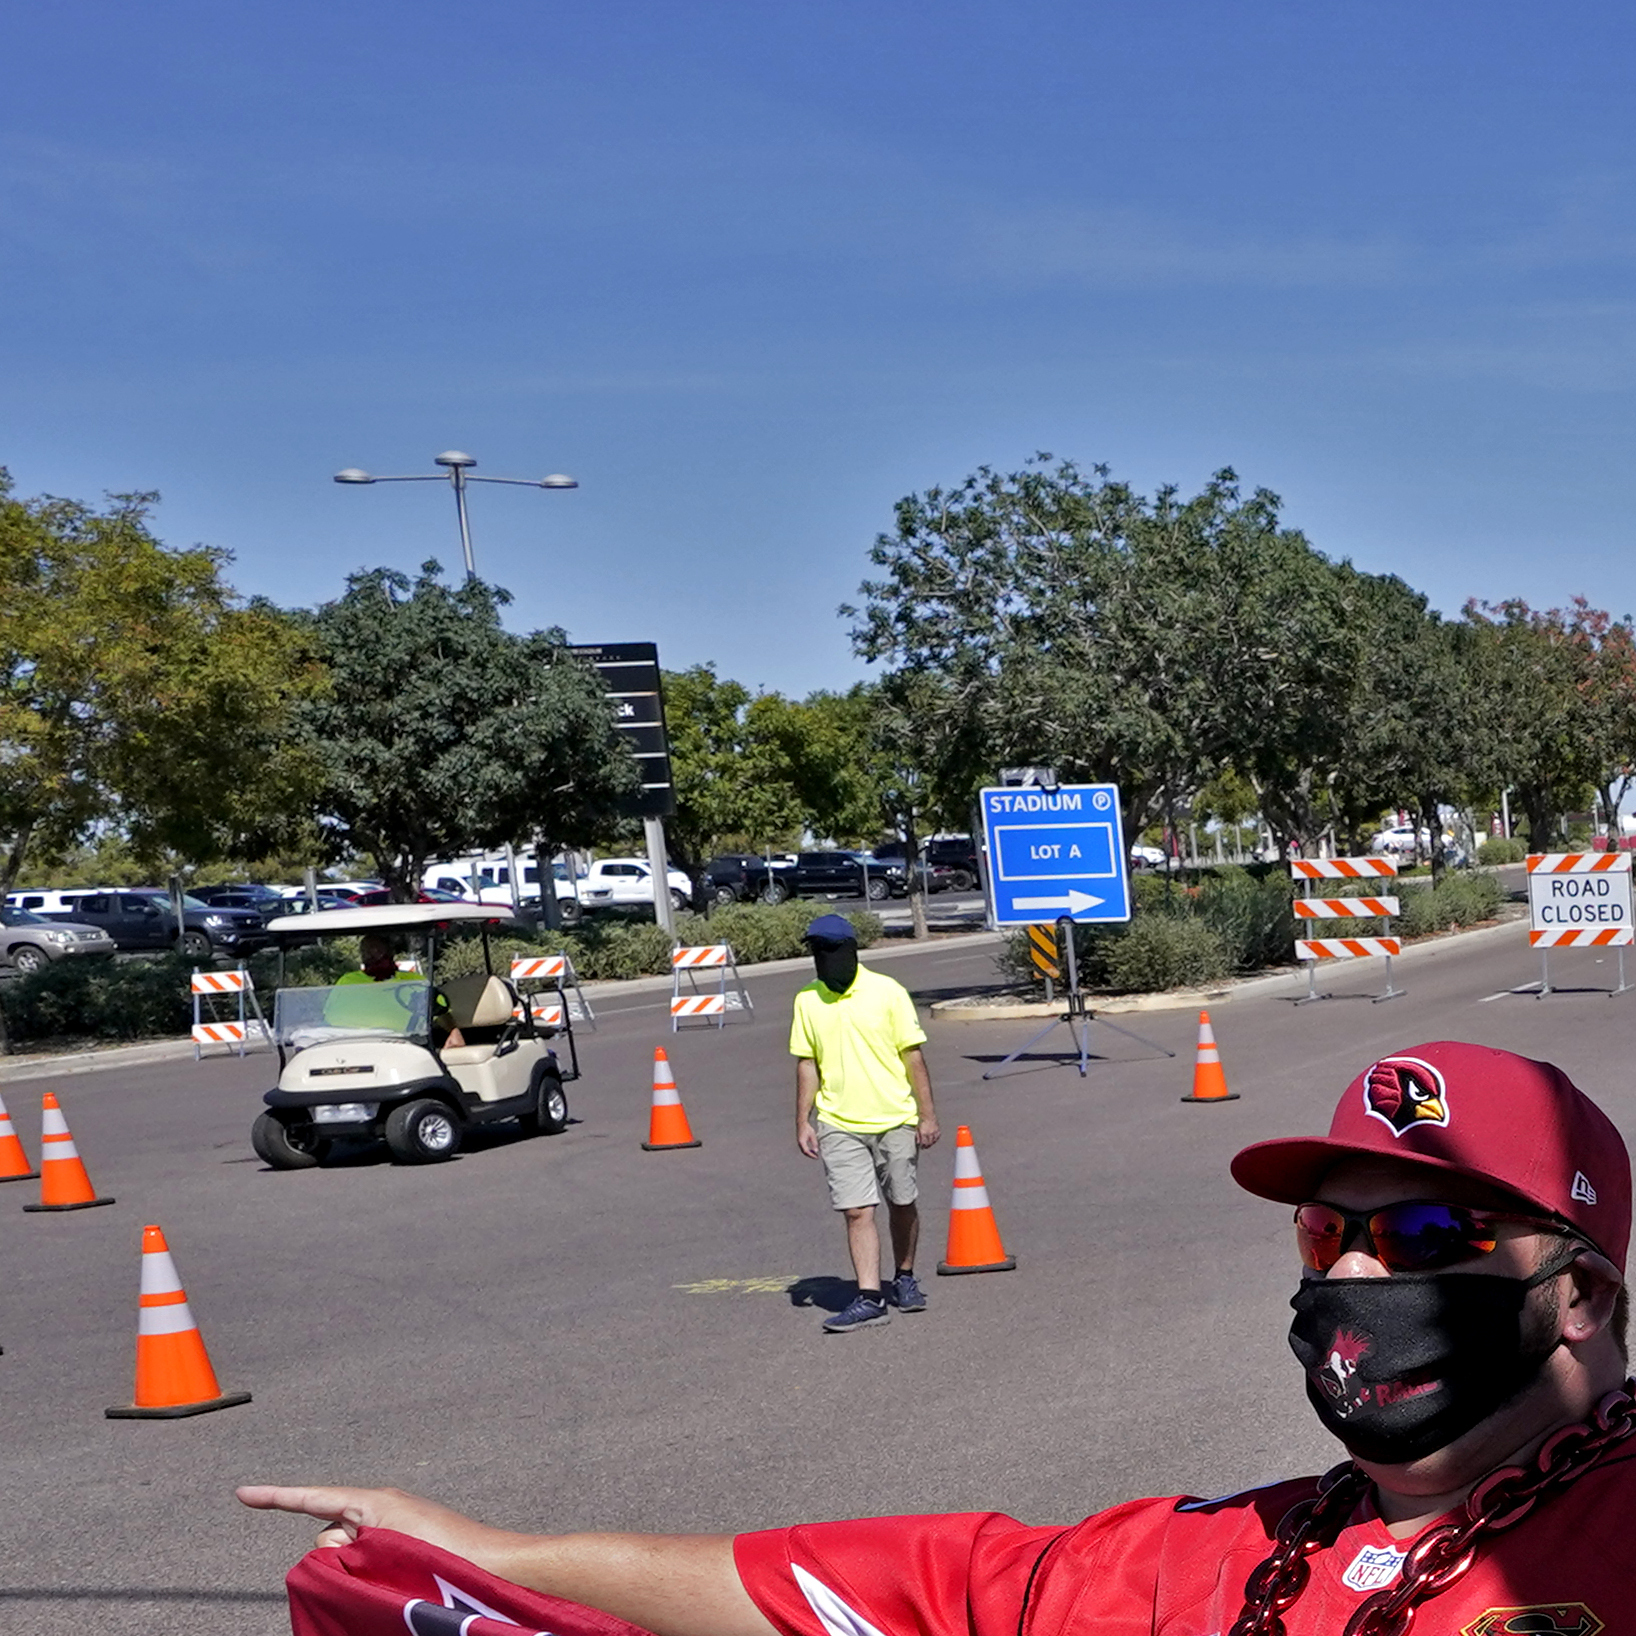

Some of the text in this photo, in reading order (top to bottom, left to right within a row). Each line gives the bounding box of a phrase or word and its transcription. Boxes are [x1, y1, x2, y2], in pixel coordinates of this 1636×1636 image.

[989, 793, 1082, 813] STADIUM
[1030, 844, 1082, 859] LOT A
[1552, 879, 1610, 897] ROAD
[1541, 904, 1624, 923] CLOSED
[1351, 1564, 1387, 1585] NFL
